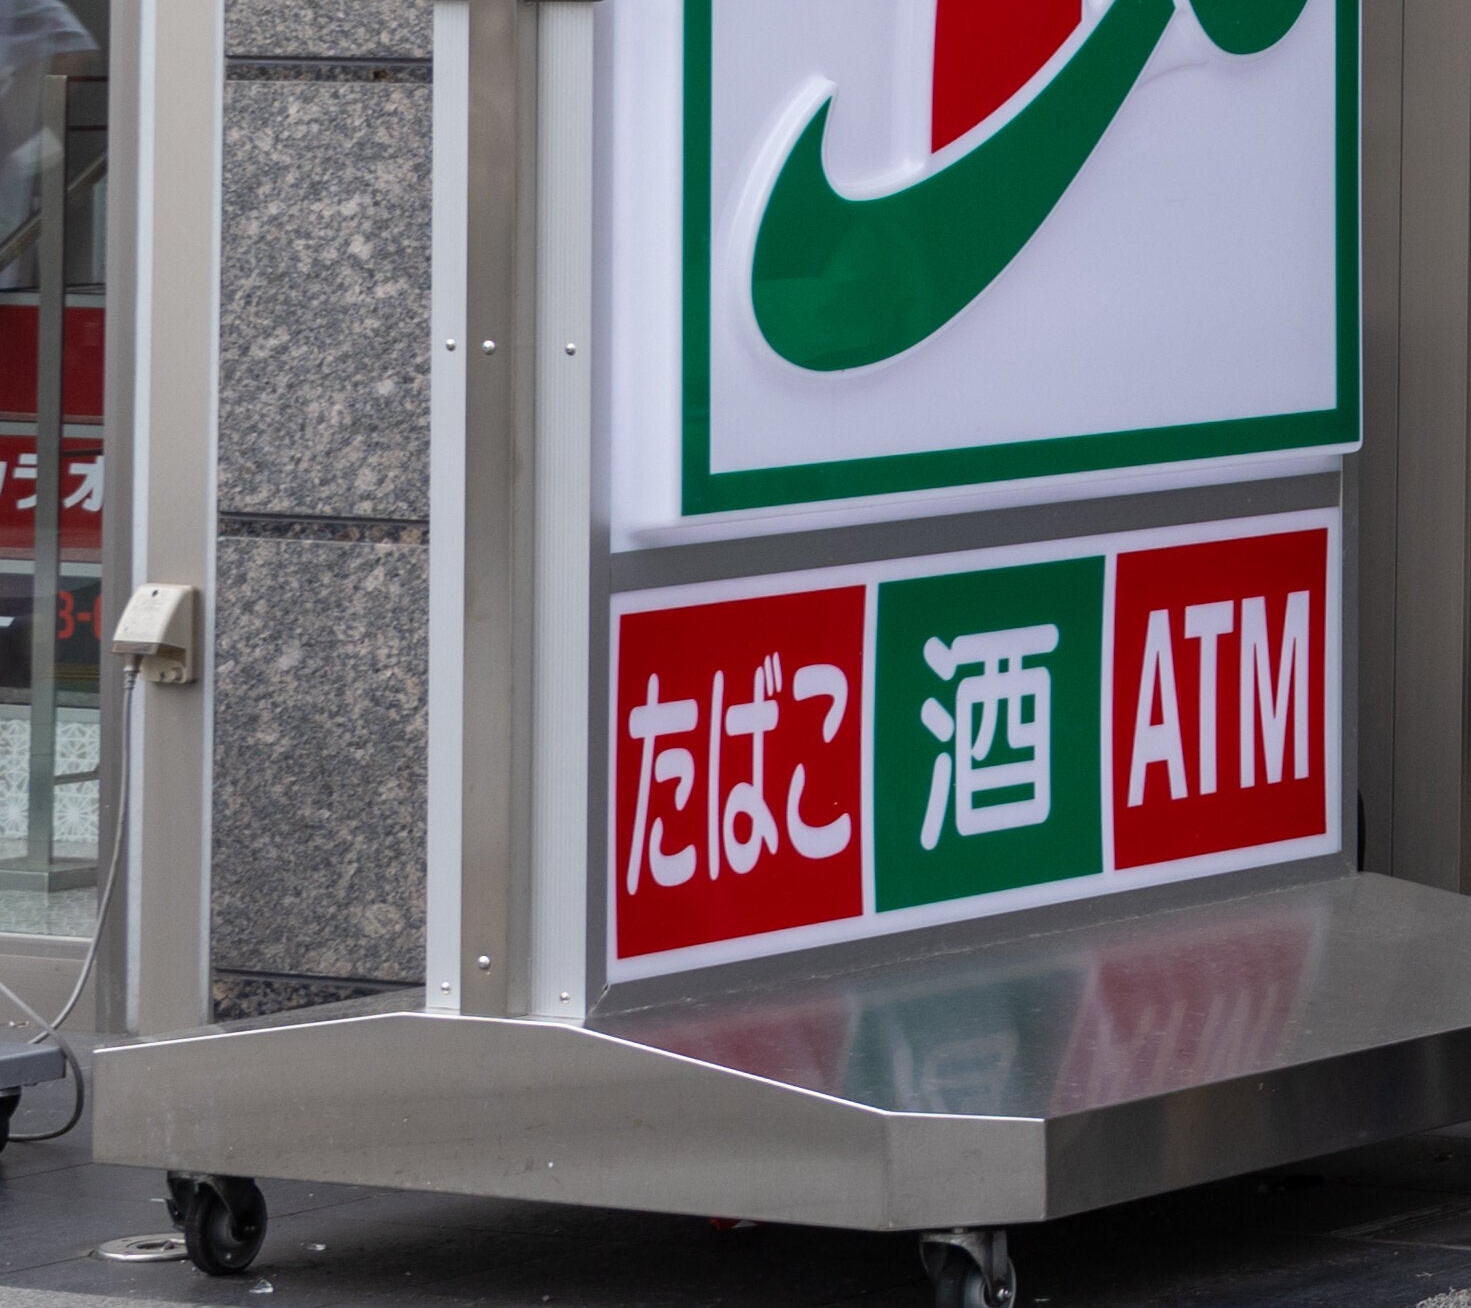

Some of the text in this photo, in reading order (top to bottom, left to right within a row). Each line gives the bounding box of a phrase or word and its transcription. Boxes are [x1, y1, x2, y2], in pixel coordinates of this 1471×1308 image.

[627, 650, 852, 896] たばこ
[919, 623, 1060, 852] 酒
[1126, 589, 1311, 809] ATM
